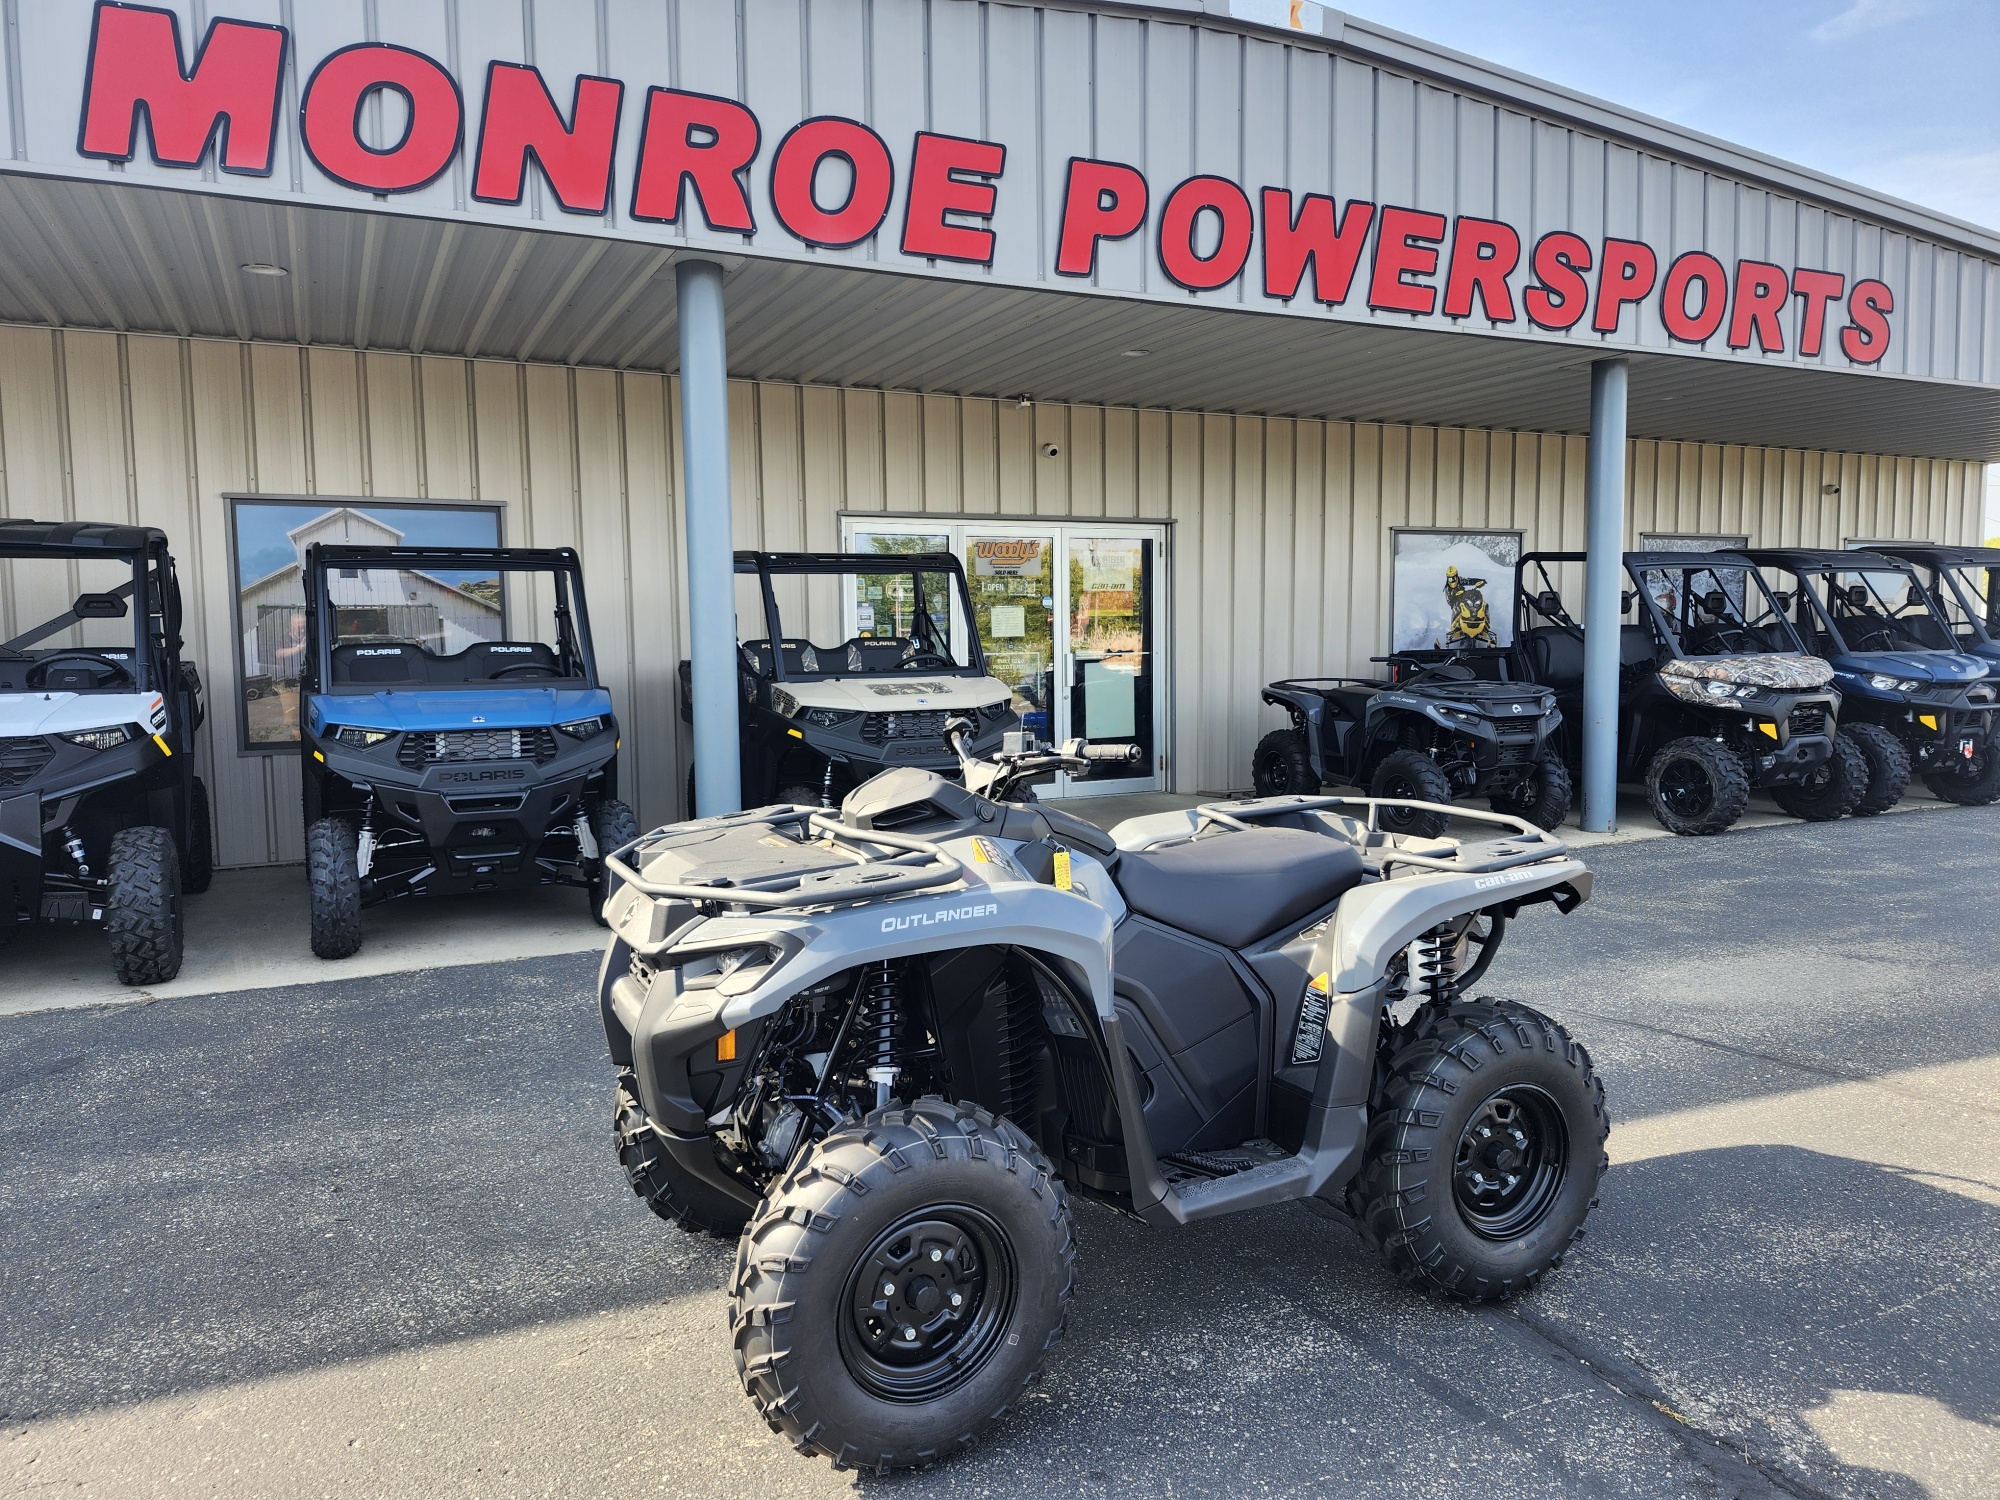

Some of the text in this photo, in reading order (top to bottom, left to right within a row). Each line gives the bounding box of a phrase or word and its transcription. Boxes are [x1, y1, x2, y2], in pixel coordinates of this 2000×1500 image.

[77, 1, 1894, 366] MONROE POWERSPORTS
[987, 583, 1004, 591] OPEN
[356, 648, 402, 656] POLARIS
[895, 745, 948, 757] POLAR
[438, 769, 526, 784] POLARIS
[881, 903, 998, 933] OUTLANDER
